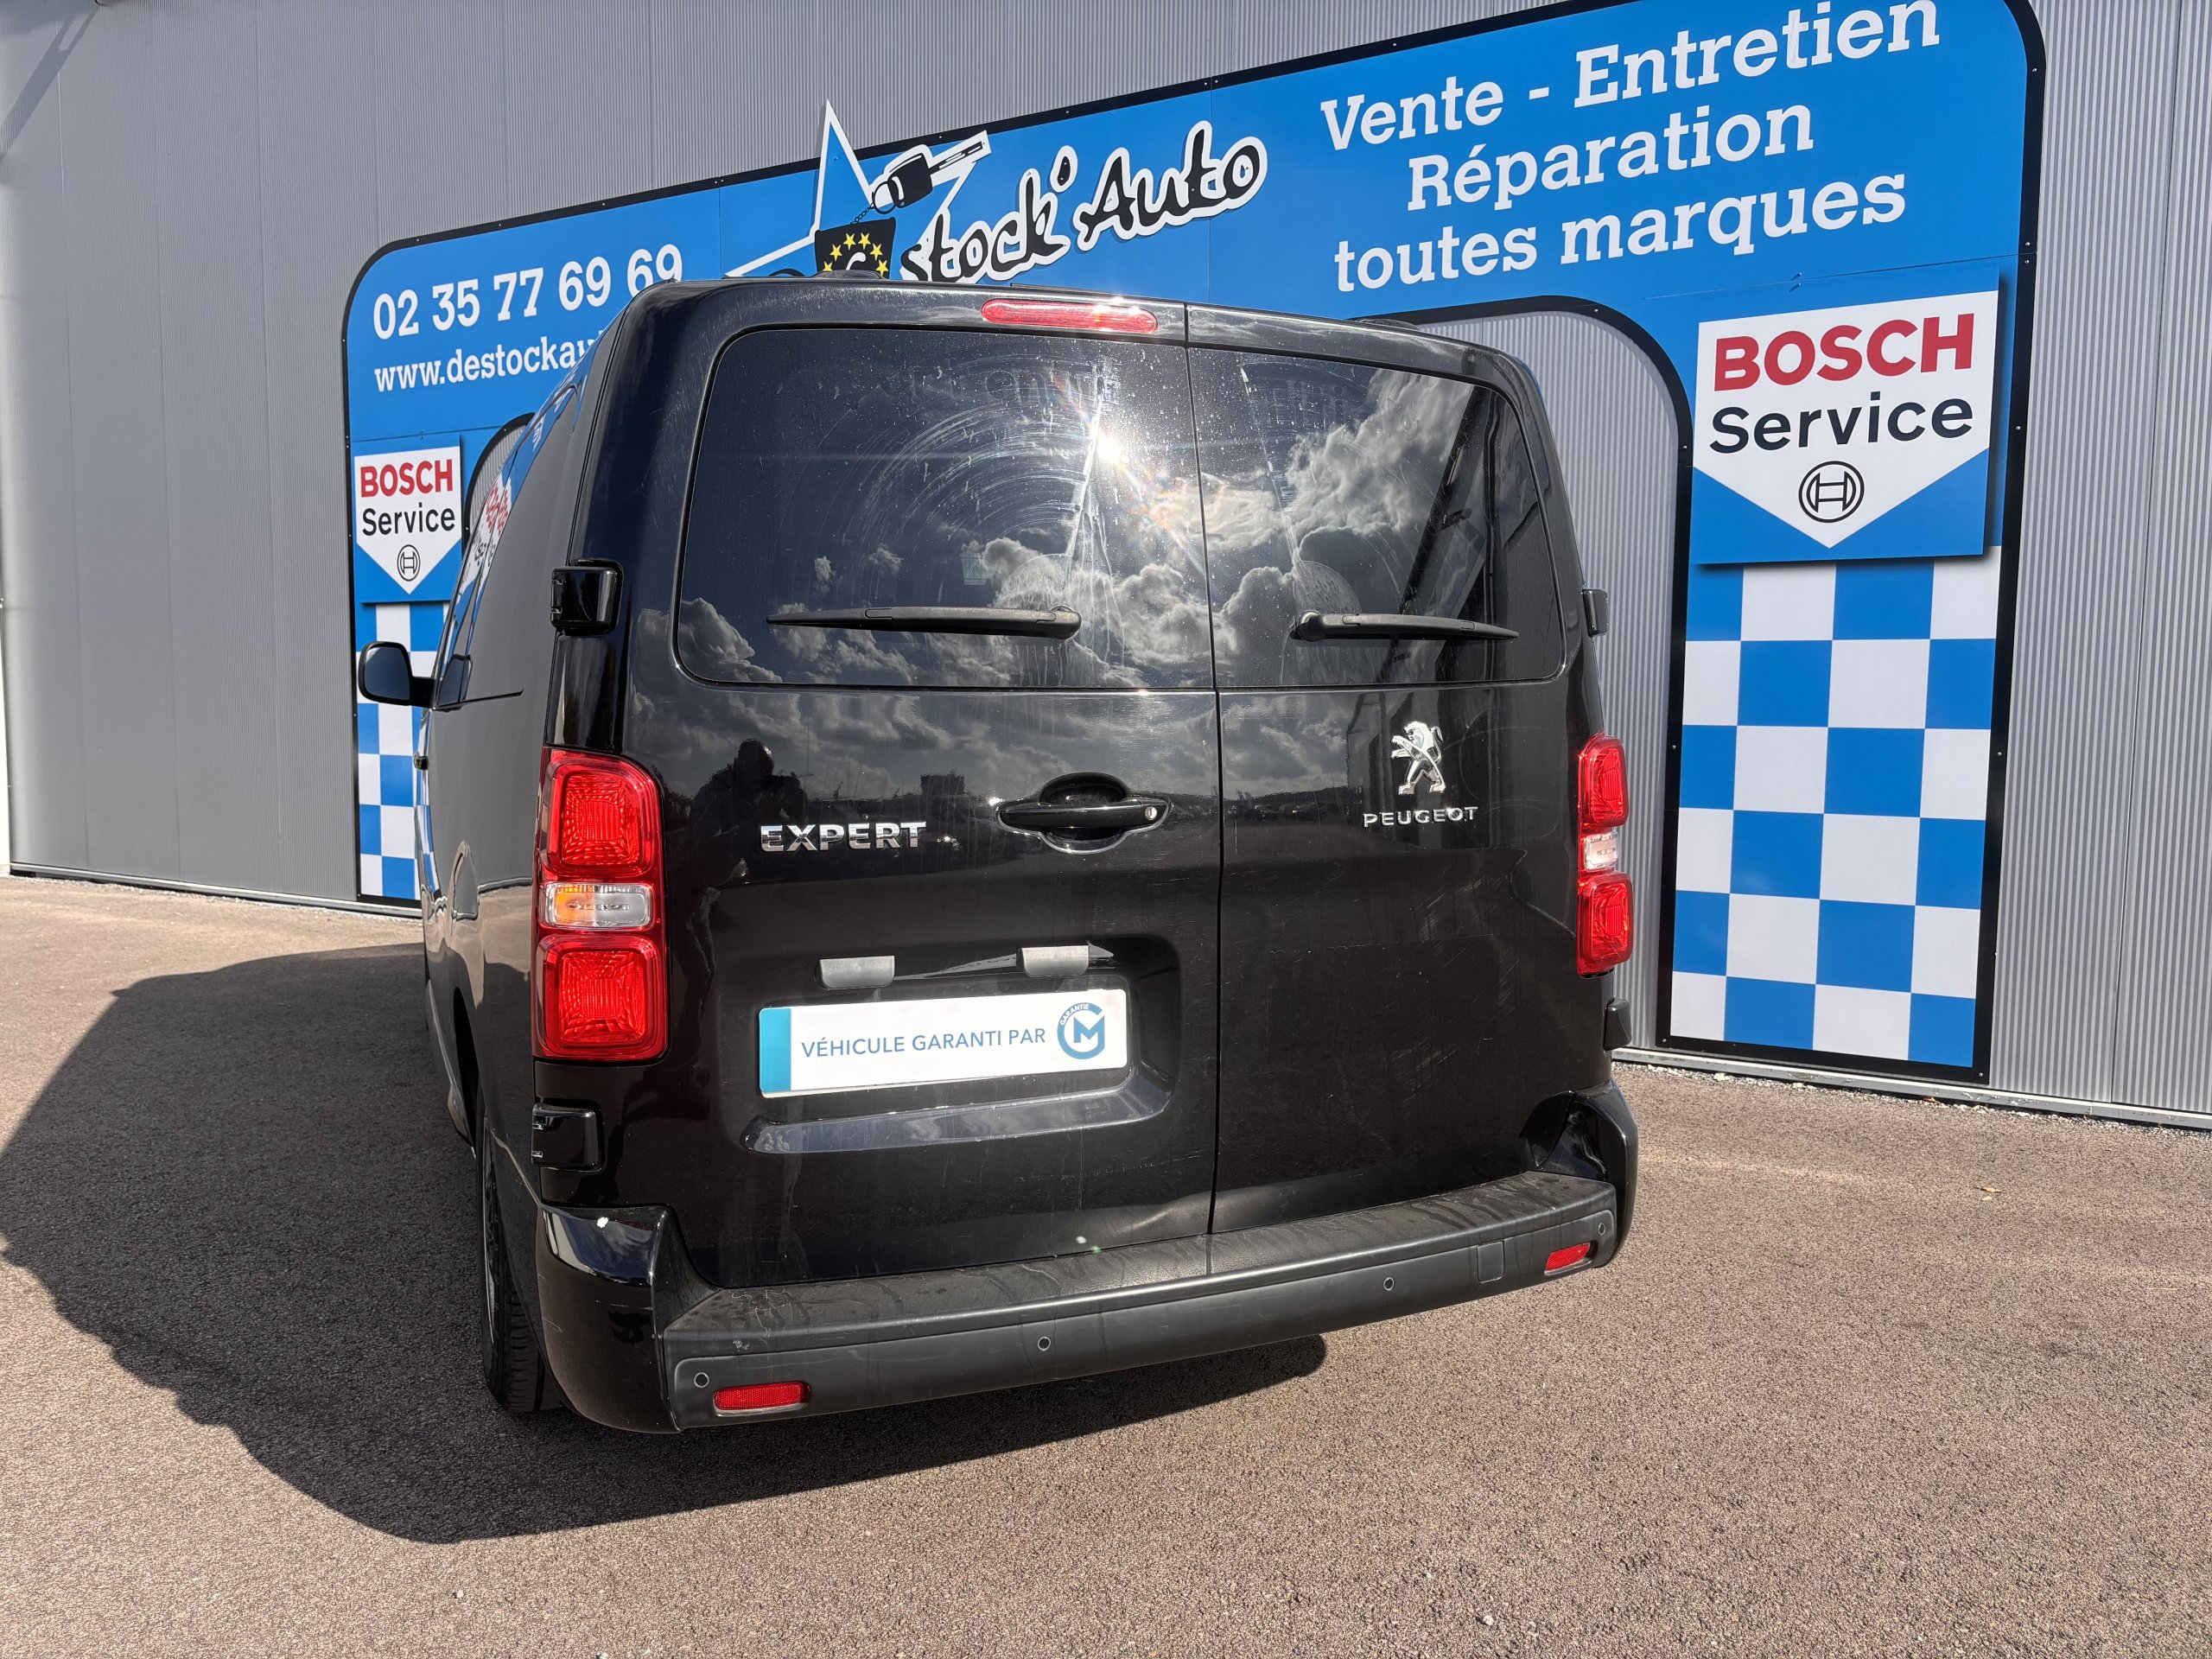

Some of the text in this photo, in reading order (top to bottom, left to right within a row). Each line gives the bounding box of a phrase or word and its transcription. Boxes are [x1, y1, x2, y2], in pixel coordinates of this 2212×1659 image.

[1320, 76, 1503, 150] Vente
[1573, 0, 1940, 108] Entretien
[1408, 105, 1814, 210] Réparation
[1334, 174, 1906, 292] toutes marques
[373, 244, 683, 340] 02 35 77 69 69
[374, 329, 603, 392] www.destocka
[1714, 314, 1975, 391] BOSCH
[1709, 391, 1973, 454] Service
[360, 459, 453, 498] BOSCH
[362, 503, 455, 537] Service
[760, 821, 926, 852] EXPERT
[1363, 806, 1478, 827] PEUGEOT
[801, 1027, 1046, 1058] VÉHICULE GARANTI PAR
[1059, 1003, 1090, 1026] GARANTIE
